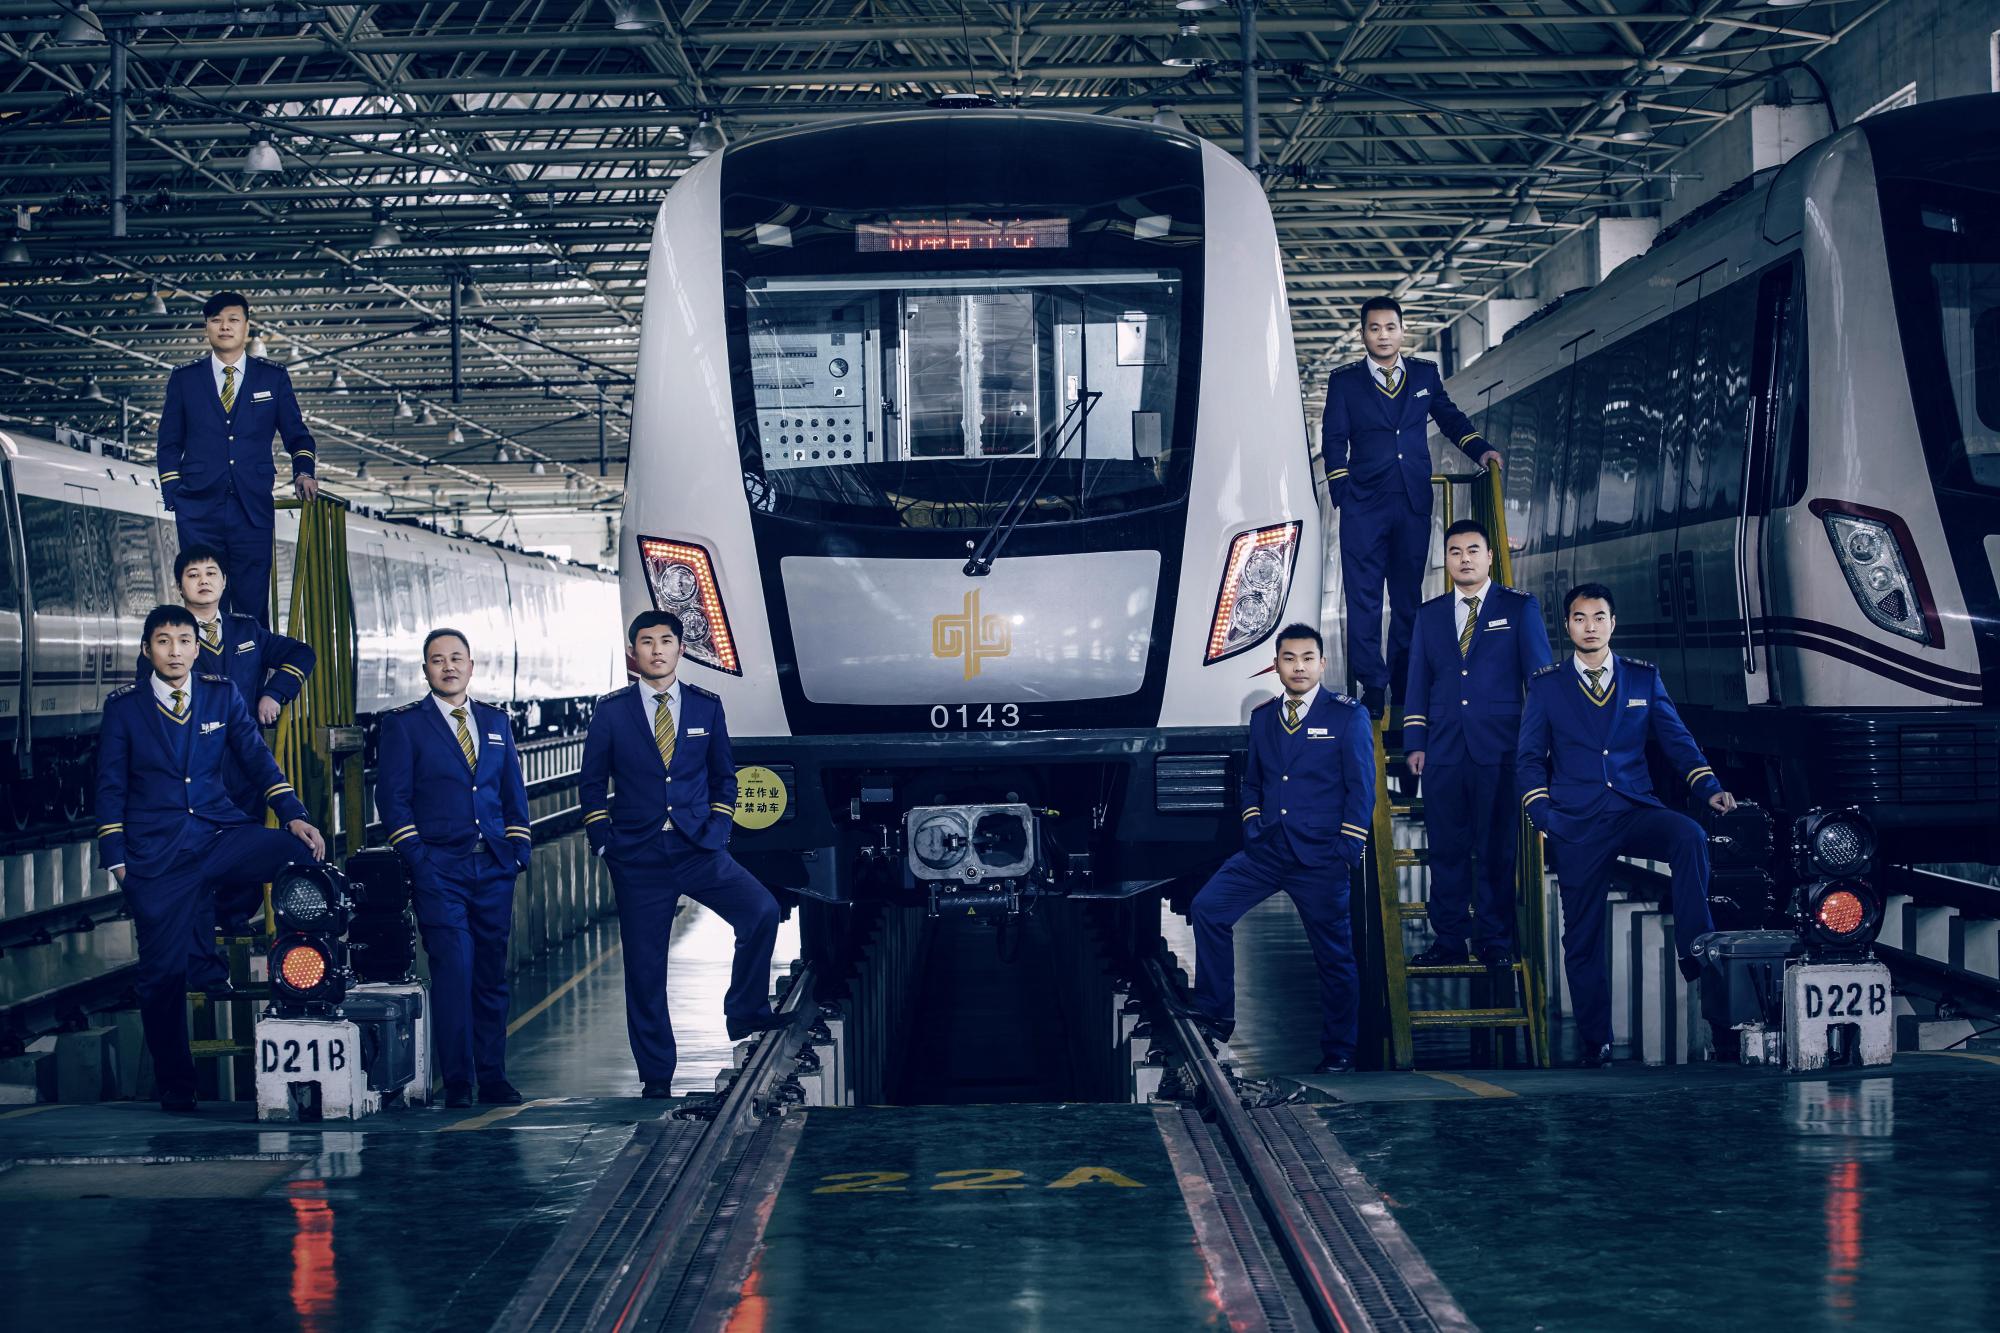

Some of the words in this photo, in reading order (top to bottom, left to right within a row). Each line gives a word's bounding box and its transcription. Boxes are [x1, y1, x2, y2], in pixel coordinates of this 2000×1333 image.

[931, 704, 1020, 728] 0143
[1806, 983, 1886, 1018] D22B
[262, 1039, 345, 1072] D21B
[812, 1167, 1146, 1193] 22A
